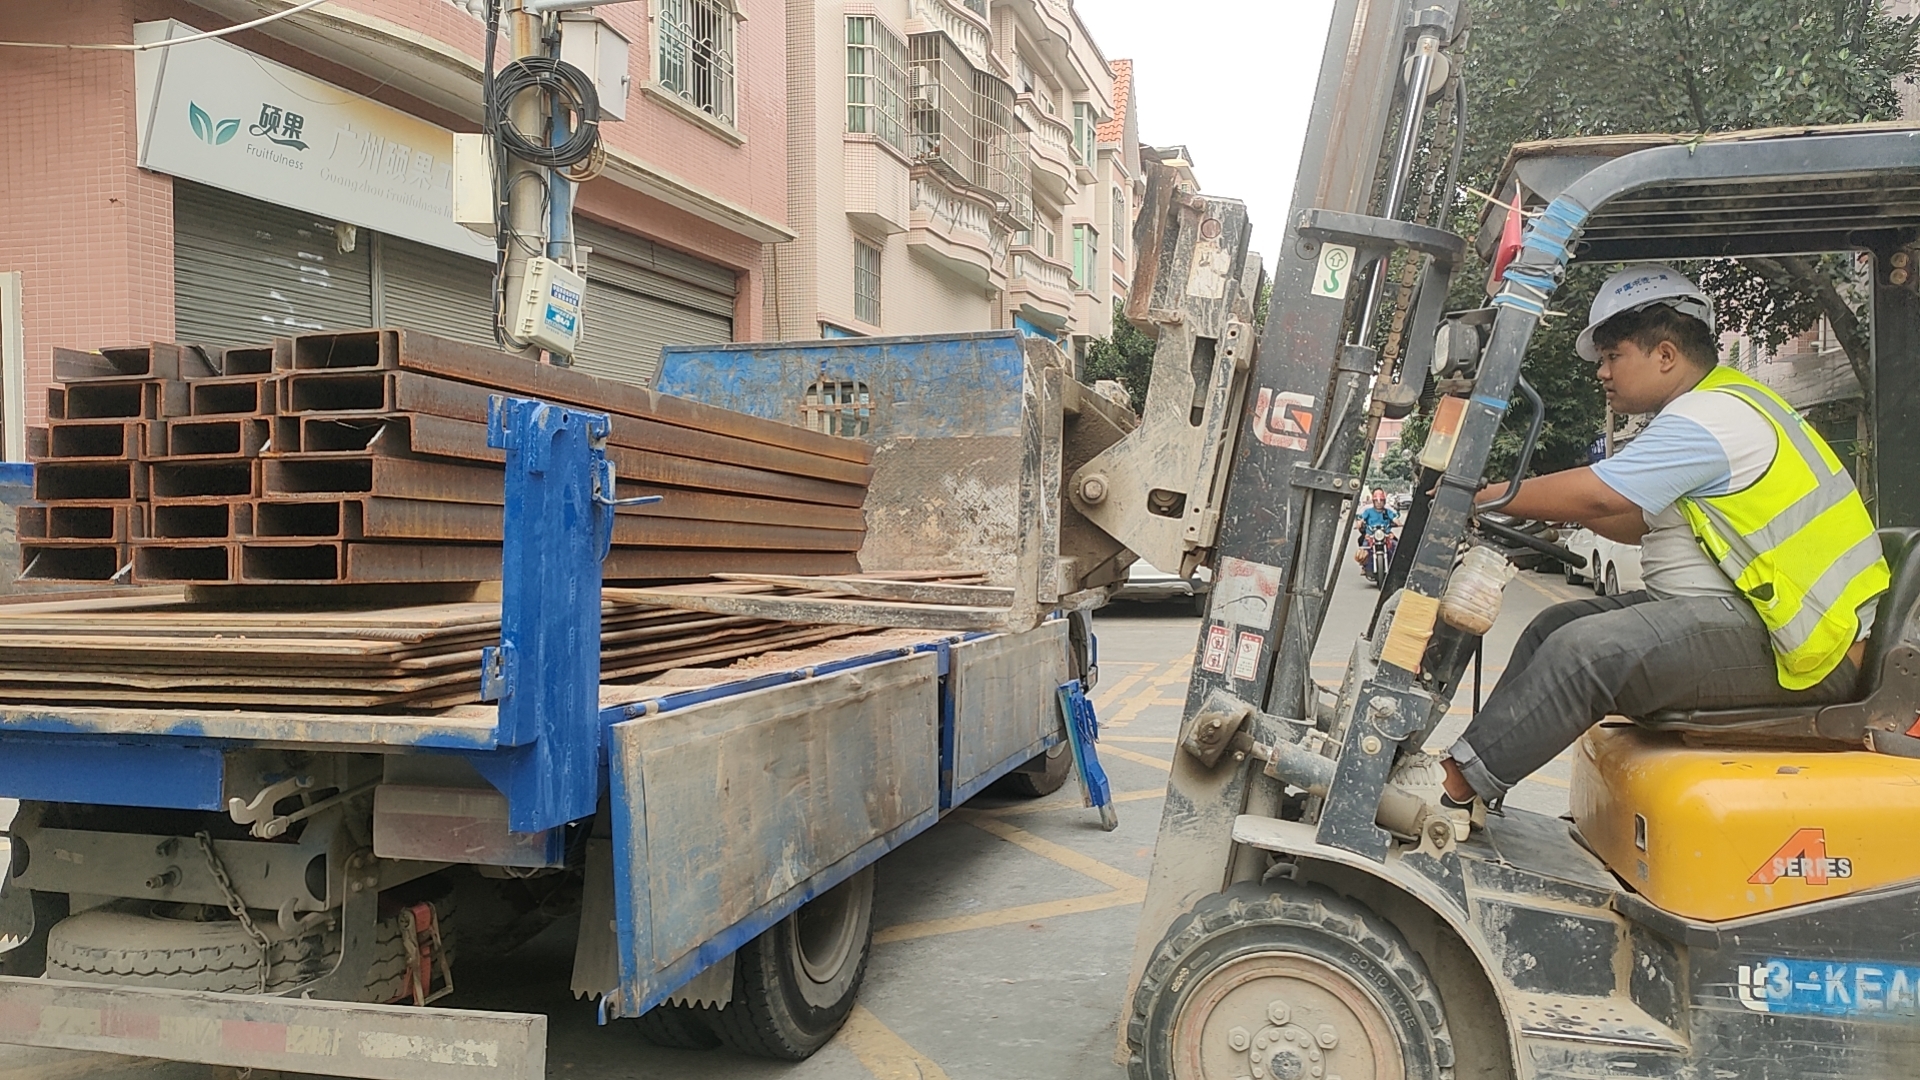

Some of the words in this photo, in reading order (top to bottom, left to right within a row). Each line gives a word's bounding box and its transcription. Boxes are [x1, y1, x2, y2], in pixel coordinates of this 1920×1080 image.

[249, 103, 307, 147] 硕果
[246, 143, 304, 171] Fruitfulness
[320, 166, 384, 198] Guangzhou
[1772, 857, 1852, 879] SERIES
[1349, 952, 1390, 988] SOLID
[1389, 988, 1417, 1029] TYRE
[1766, 961, 1920, 1012] 3-KEA
